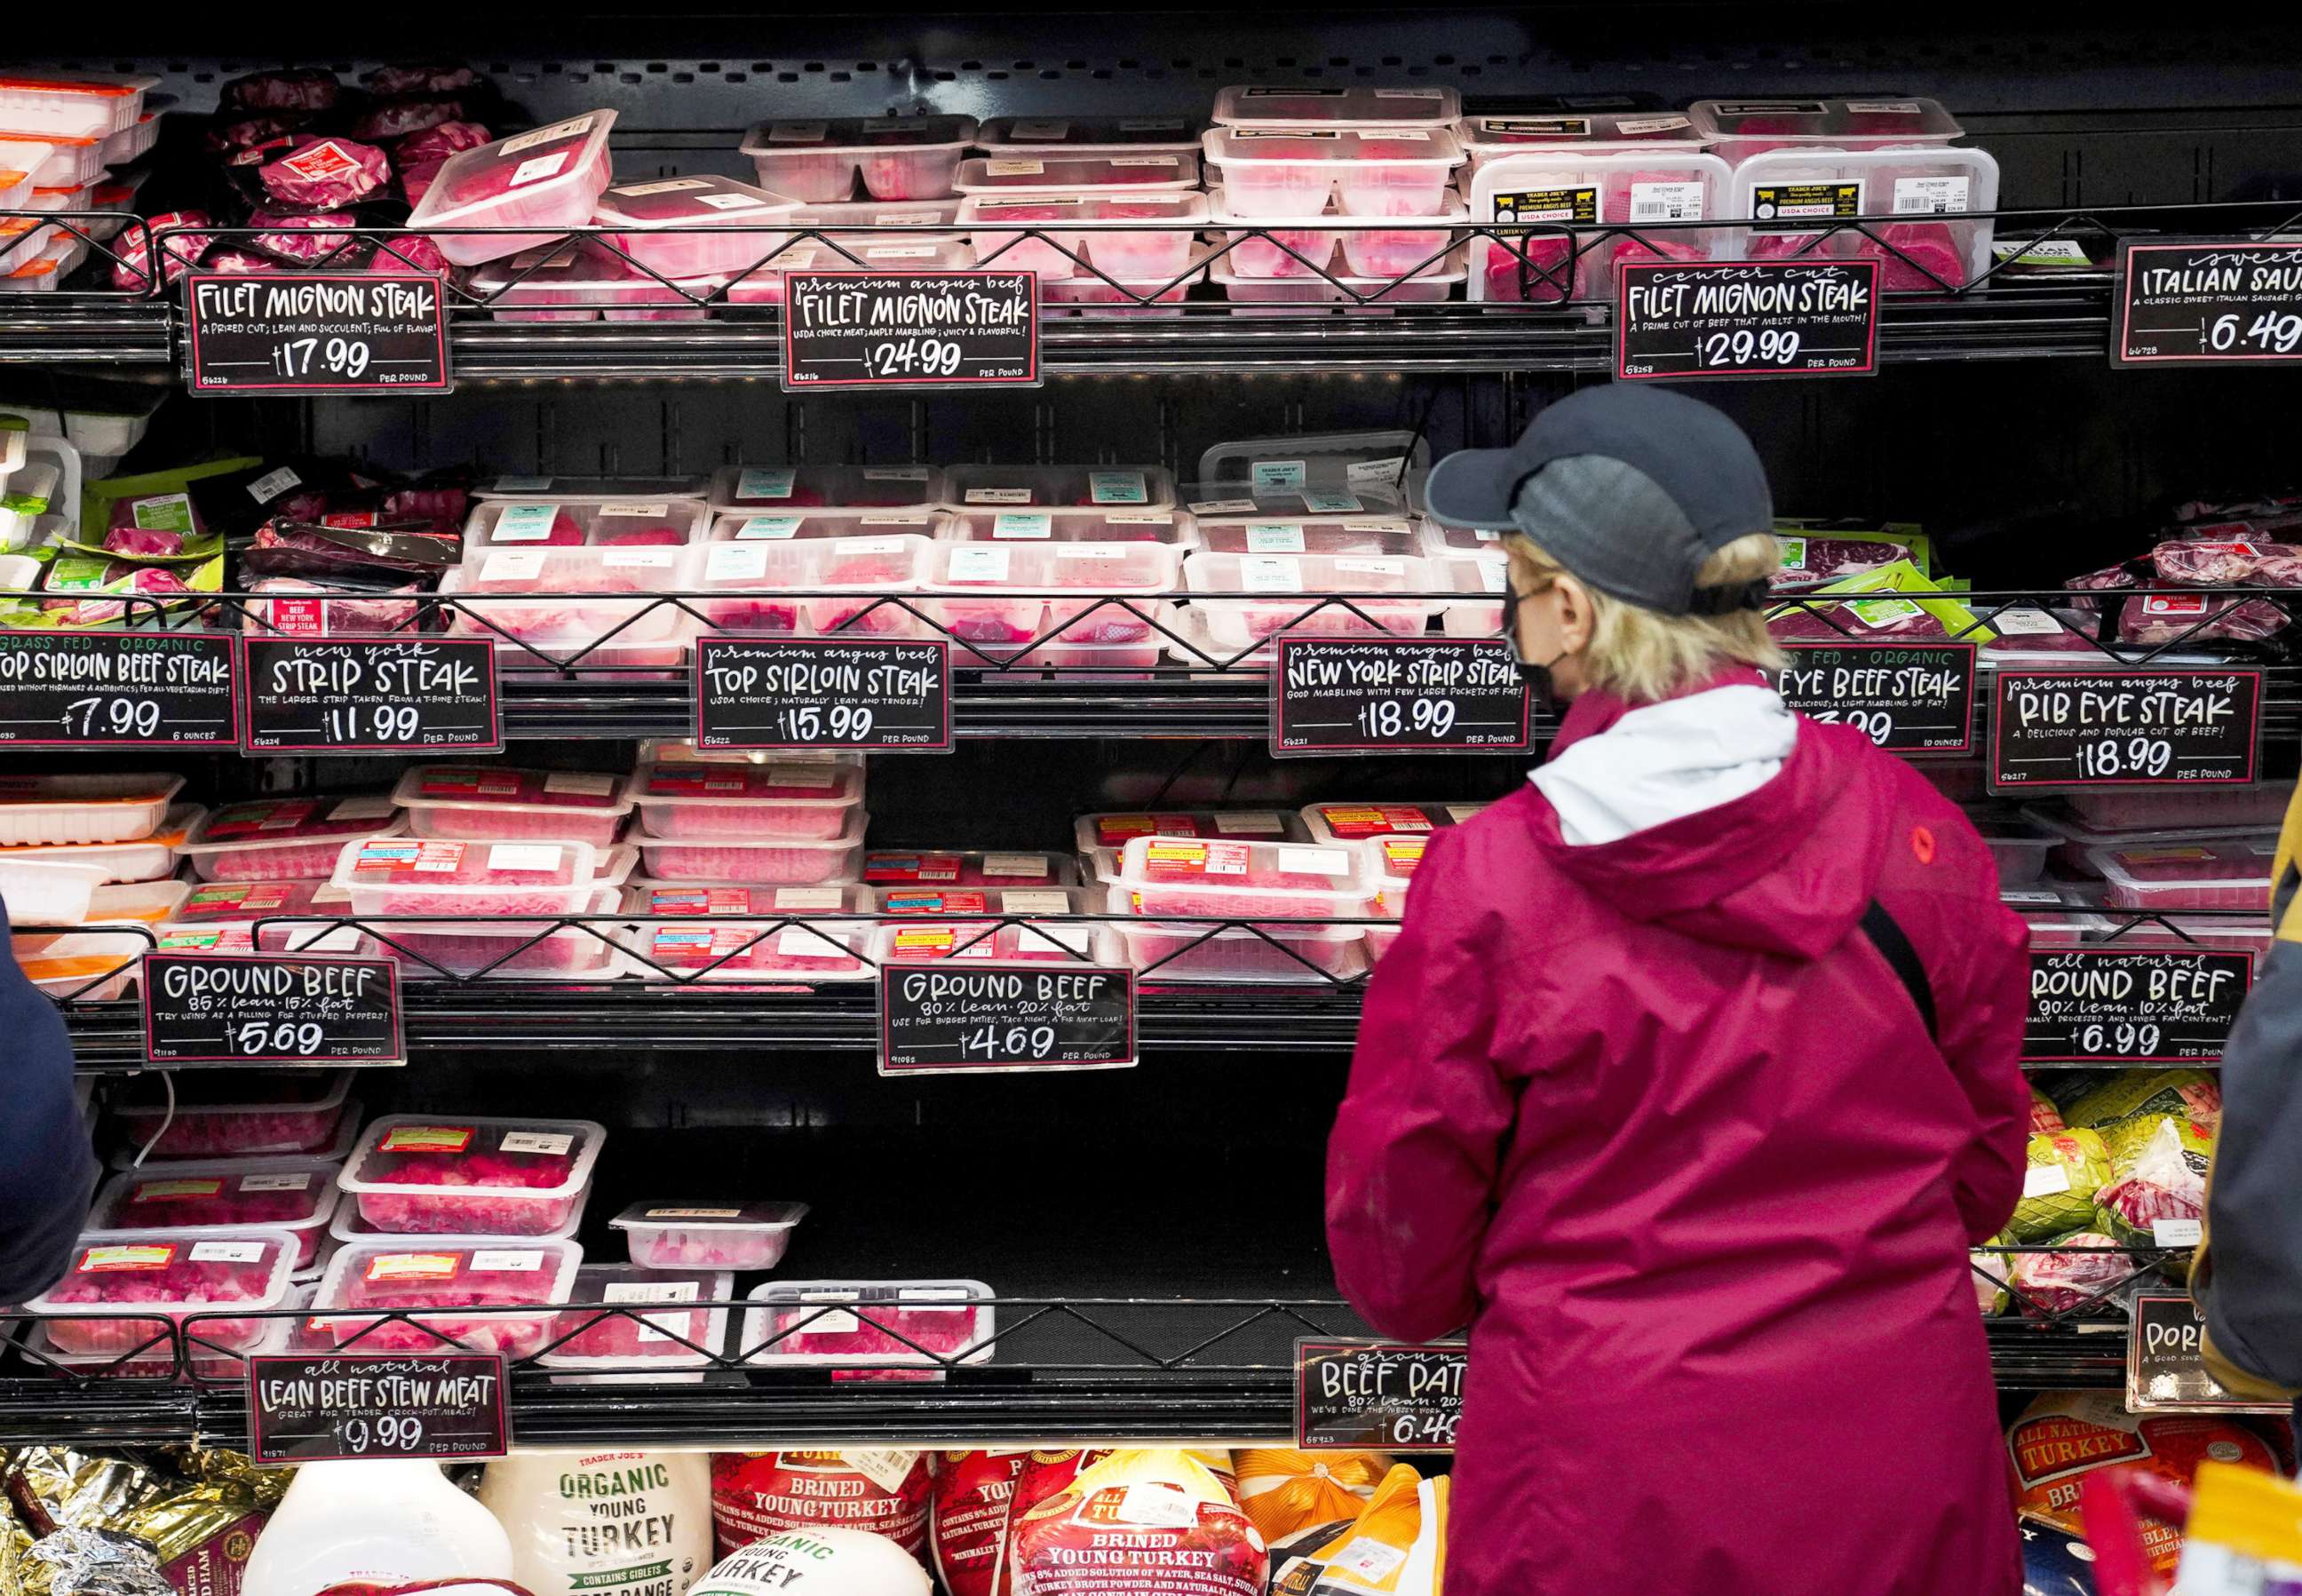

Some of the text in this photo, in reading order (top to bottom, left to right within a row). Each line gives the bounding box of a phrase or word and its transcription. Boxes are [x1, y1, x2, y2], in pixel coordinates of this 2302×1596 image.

[1653, 266, 1848, 283] center cut
[2143, 267, 2302, 295] ITALIAN SAU
[197, 283, 435, 320] FILET MIGNON STEAK
[795, 275, 1024, 306] premium angus beef
[1629, 280, 1868, 321] FILET MIGNON STEAK
[804, 292, 1028, 327] FILET MIGNON STEAK
[202, 325, 209, 334] A
[211, 324, 244, 333] PRIZED
[273, 324, 295, 333] LEAN
[319, 322, 371, 334] SUCCULENT;
[374, 324, 391, 333] FULL
[0, 637, 204, 652] GRASS FED ORGANIC
[295, 642, 440, 665] new york
[1288, 644, 1389, 666] premium
[1396, 646, 1465, 660] angus
[34, 653, 110, 681] SIRLOIN
[117, 654, 164, 682] BEEF
[167, 654, 229, 684] STEAK
[707, 646, 938, 669] premium angus beef
[1812, 651, 1954, 665] FED ORGANIC
[273, 660, 479, 695] STRIP STEAK
[705, 663, 938, 697] TOP SIRLOIN STEAK
[1288, 659, 1522, 689] NEW YORK STRIP STEAK
[1779, 668, 1960, 699] EYE BEEF STEAK
[2007, 676, 2240, 702] premium angus beef
[882, 696, 925, 708] TENDER!
[2020, 692, 2234, 727] RIB EYE STEAK
[173, 731, 179, 740] 6
[424, 733, 478, 743] PER POUND
[883, 734, 901, 743] PER
[2048, 954, 2205, 970] all natural
[164, 965, 376, 997] GROUND BEEF
[903, 973, 1107, 1002] GROUND BEEF
[2149, 970, 2235, 1002] BEEF
[188, 996, 353, 1013] 85% lean 15% fat
[920, 999, 1091, 1016] 80% lean 20% fat
[2039, 1000, 2209, 1019] 90% lean 10% fat
[305, 1360, 450, 1376] all natural
[1322, 1362, 1467, 1398] BEEF PAT
[260, 1375, 496, 1412] LEAN BEEF STEW MEAT
[1348, 1396, 1428, 1407] 80% lean
[579, 1454, 615, 1466] TRADER
[2023, 1432, 2130, 1471] TURKEY
[560, 1464, 669, 1498] ORGANIC
[790, 1478, 865, 1497] BRINED
[590, 1498, 646, 1518] YOUNG
[755, 1492, 901, 1518] YOUNG TURKEY
[561, 1513, 674, 1557] TURKEY
[1093, 1534, 1177, 1548] BRINED
[198, 1550, 210, 1584] HAM
[1048, 1547, 1216, 1568] YOUNG TURKEY
[583, 1566, 661, 1586] CONTAINS GIBLETS
[1037, 1570, 1052, 1580] 8%
[1155, 1569, 1193, 1580] WATER,
